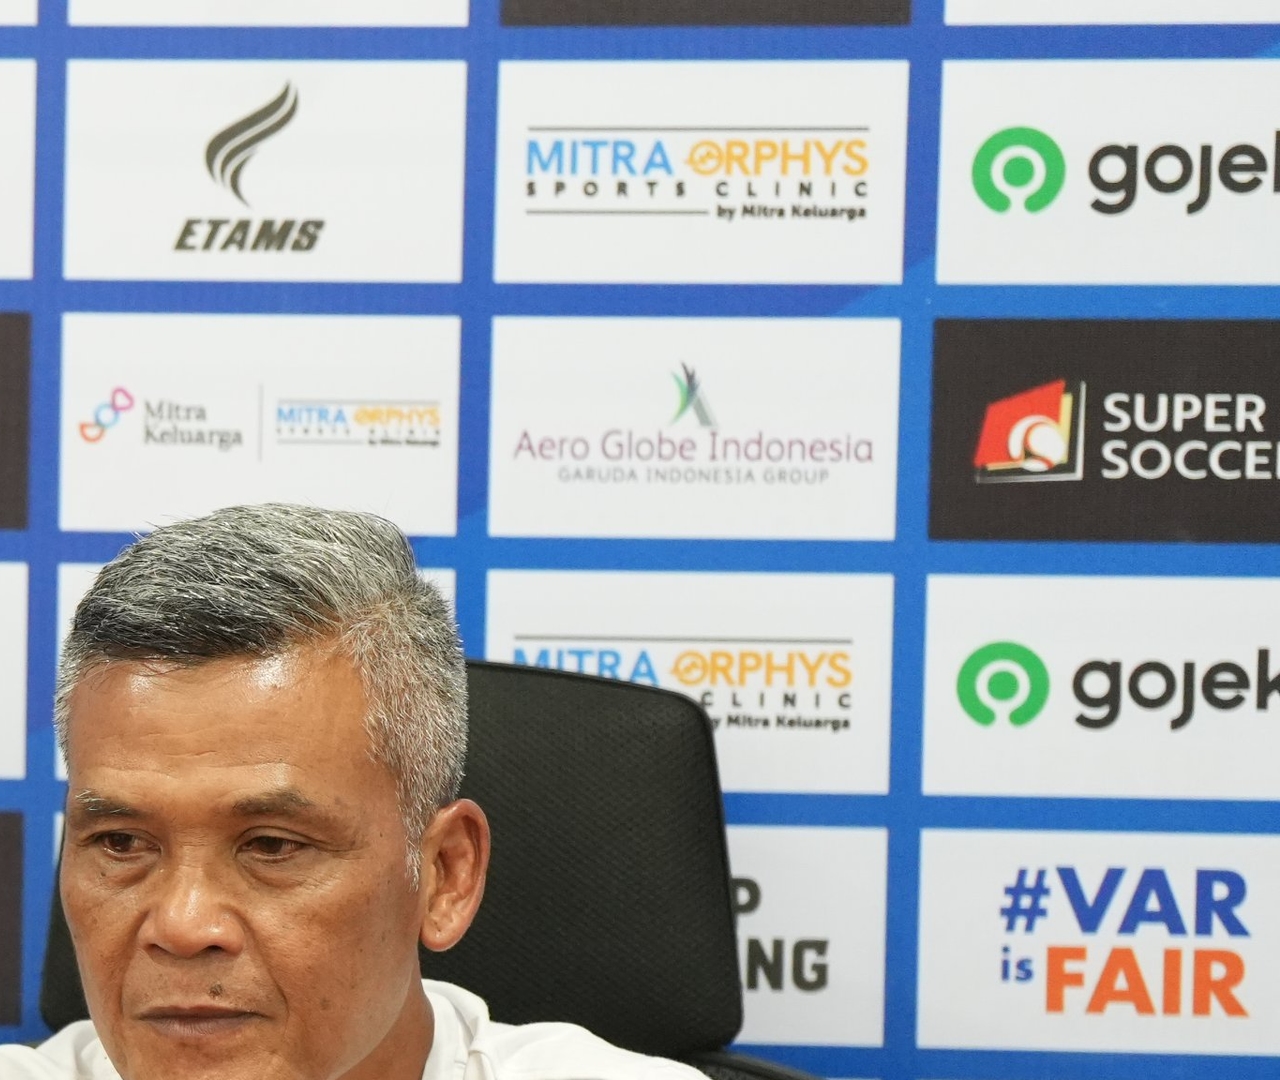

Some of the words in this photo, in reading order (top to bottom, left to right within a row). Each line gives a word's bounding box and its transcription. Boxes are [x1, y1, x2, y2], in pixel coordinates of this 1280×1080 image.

[526, 140, 674, 176] MITRA
[685, 140, 870, 177] ORPHYS
[1088, 129, 1280, 215] goje
[525, 181, 686, 198] SPORTS
[715, 181, 869, 198] CLINIC
[716, 204, 736, 222] by
[741, 204, 785, 219] Mitra
[790, 204, 867, 222] Keluarga
[173, 218, 326, 253] ETAMS
[143, 400, 207, 422] Mitra
[276, 407, 347, 425] MITRA
[353, 407, 440, 426] ORPHYS
[1102, 392, 1266, 433] SUPER
[143, 427, 243, 452] Keluarga
[514, 431, 590, 461] Aero
[600, 430, 697, 462] Globe
[708, 431, 874, 463] Indonesia
[558, 466, 638, 484] GARUDA
[646, 467, 756, 485] INDONESIA
[763, 468, 830, 485] GROUP
[1100, 439, 1280, 480] SOCCE
[671, 650, 853, 688] ORPHYS
[727, 715, 770, 729] Mitra
[776, 716, 852, 733] Keluarga
[999, 867, 1251, 937] #VAR
[1001, 948, 1033, 983] is
[1045, 947, 1250, 1018] FAIR
